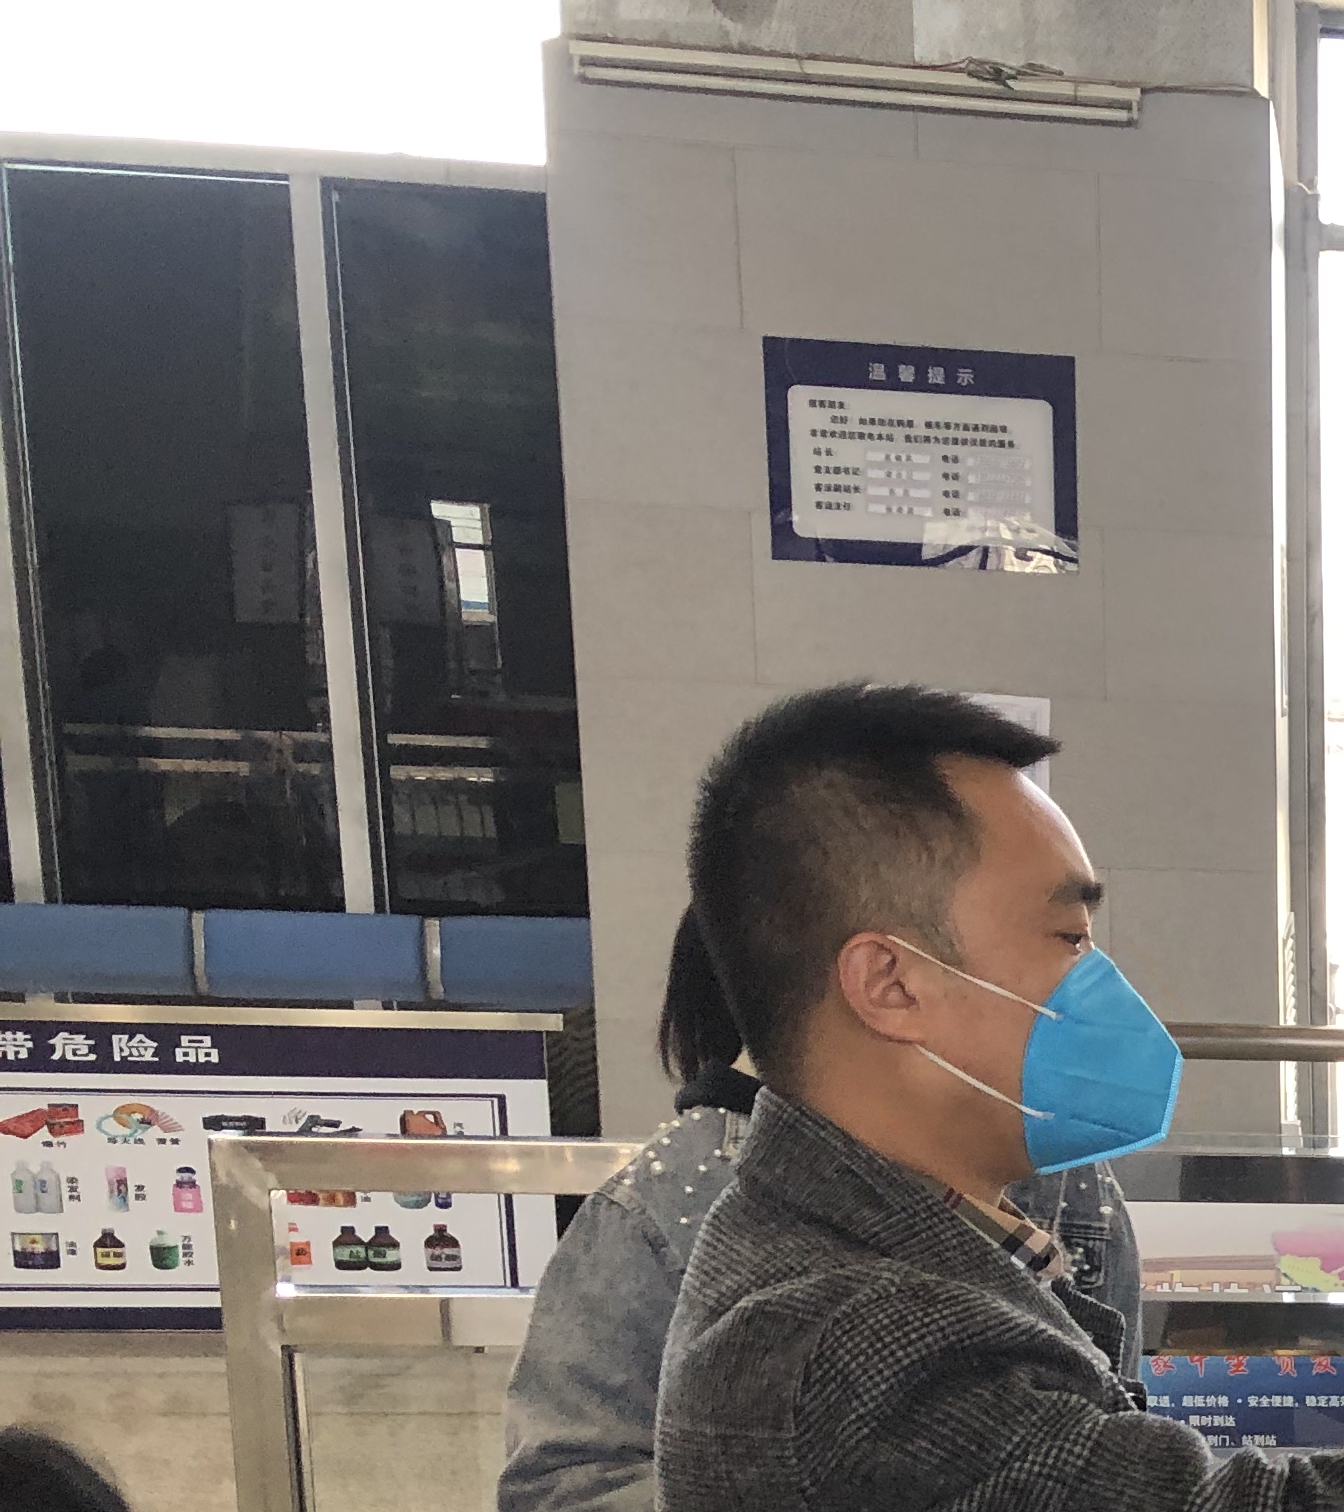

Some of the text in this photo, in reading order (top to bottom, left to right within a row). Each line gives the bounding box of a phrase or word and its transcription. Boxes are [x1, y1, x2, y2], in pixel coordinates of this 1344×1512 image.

[868, 362, 974, 386] 温馨提示
[0, 1030, 220, 1063] 带危险品
[1203, 1434, 1277, 1447] 到门、站到站
